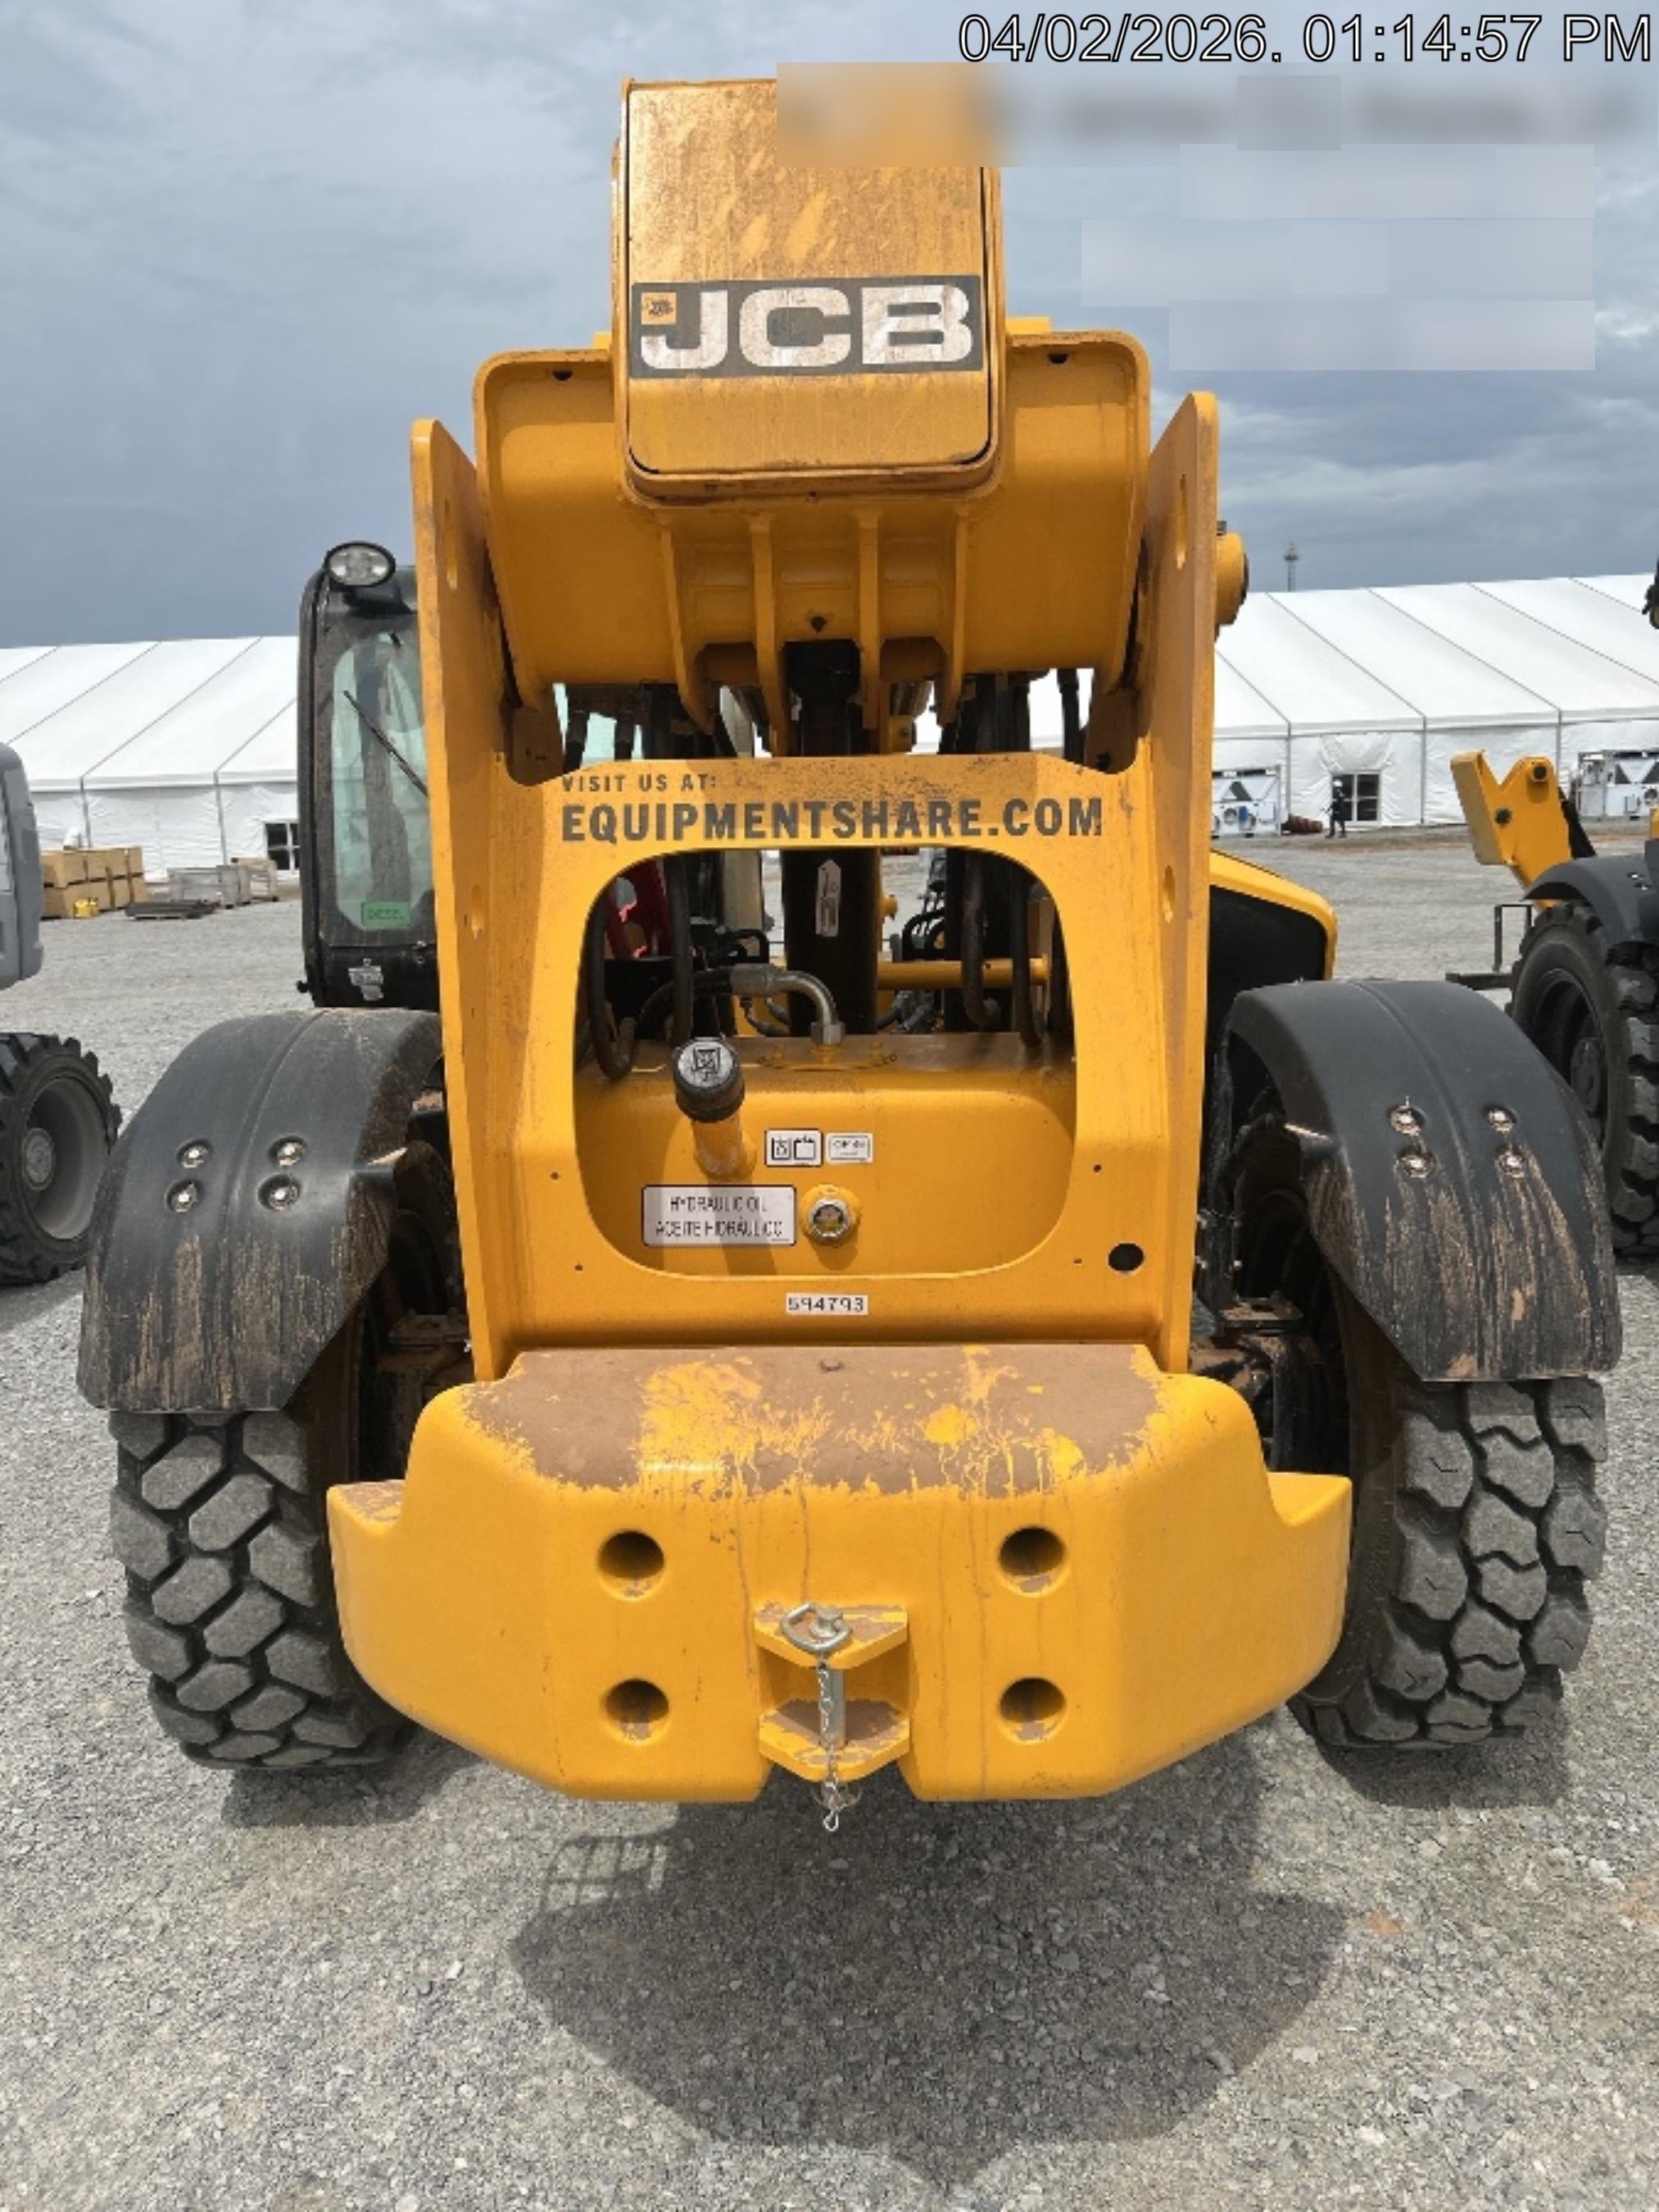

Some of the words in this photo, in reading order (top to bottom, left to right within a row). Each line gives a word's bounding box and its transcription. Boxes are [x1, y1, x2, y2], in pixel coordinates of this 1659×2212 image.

[639, 284, 974, 370] JCB
[562, 774, 627, 792] VISIT
[639, 773, 668, 792] US
[681, 773, 717, 791] AT:
[562, 797, 1103, 844] EQUIPMENTSHARE.COM
[670, 1196, 743, 1212] HYDRAULIC
[746, 1196, 768, 1212] OIL
[655, 1220, 701, 1237] ACEITE
[787, 1297, 864, 1312] 594793
